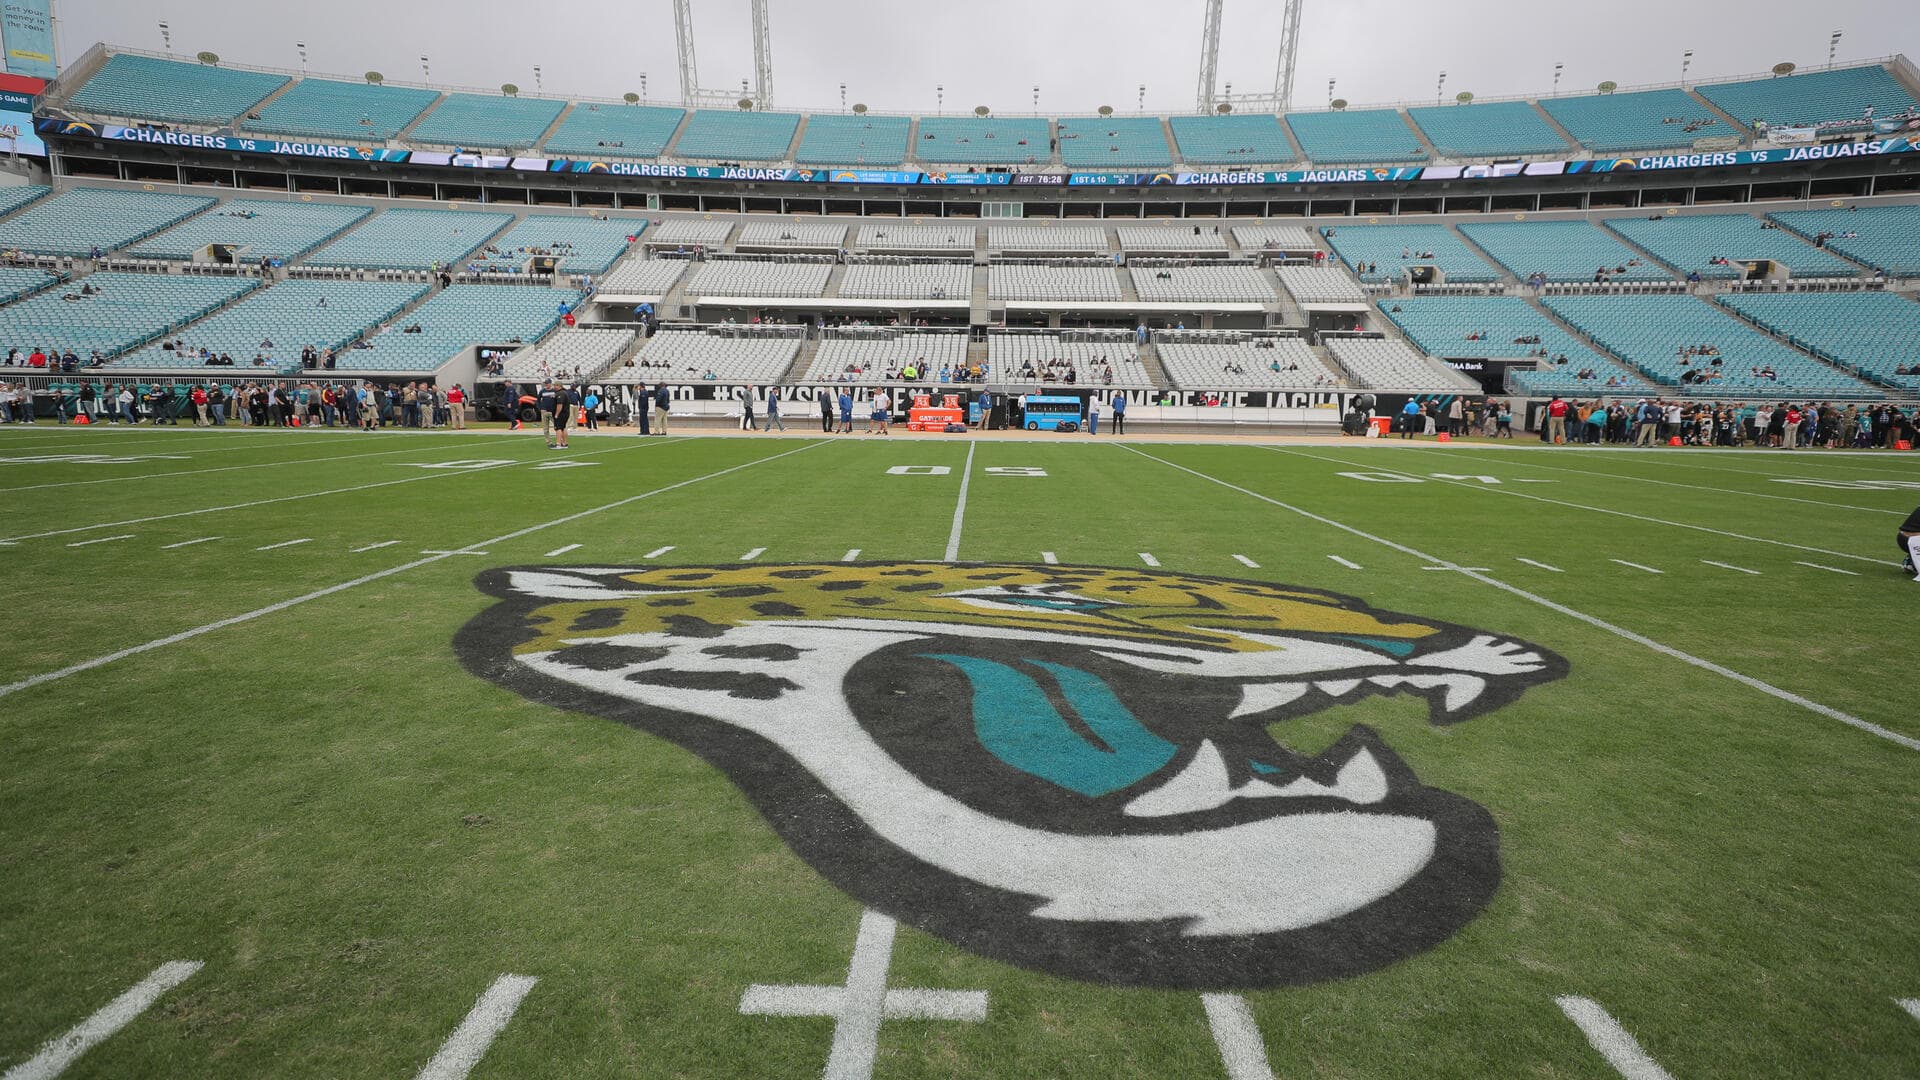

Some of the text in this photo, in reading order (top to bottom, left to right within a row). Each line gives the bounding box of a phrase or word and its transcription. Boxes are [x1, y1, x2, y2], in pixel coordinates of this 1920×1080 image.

[23, 8, 43, 16] your
[5, 14, 33, 23] money
[24, 24, 44, 32] zone
[4, 95, 28, 104] GAME
[123, 128, 349, 158] CHARGERS VS JAGUARS
[1640, 141, 1881, 169] CHARGERS VS JAGUARS
[612, 163, 784, 181] CHARGERS VS JAGUARS
[998, 175, 1004, 183] 0
[1020, 175, 1034, 183] 1ST
[1075, 176, 1089, 184] 1ST
[1190, 170, 1366, 184] CHARGERS VS JAGUARS
